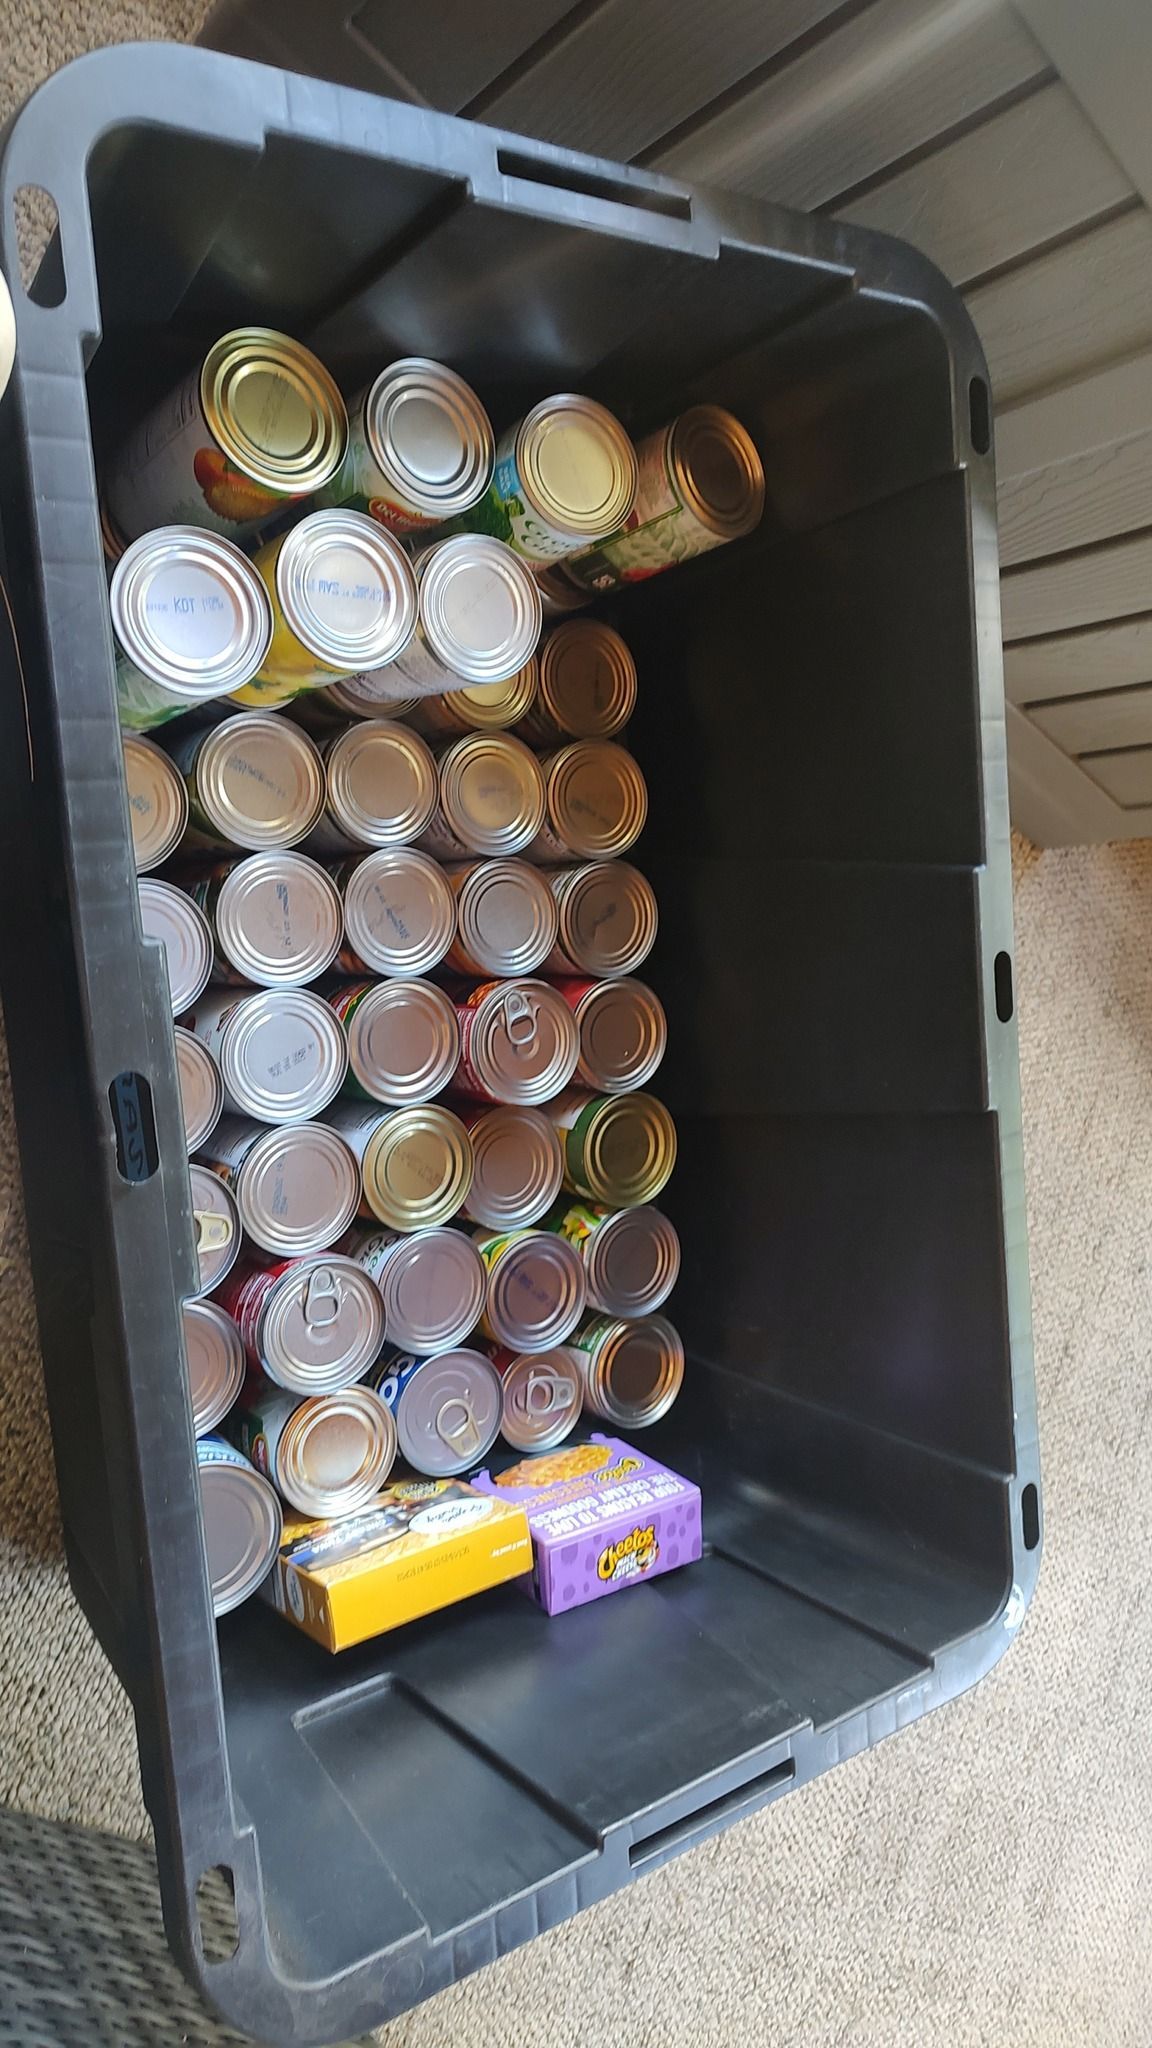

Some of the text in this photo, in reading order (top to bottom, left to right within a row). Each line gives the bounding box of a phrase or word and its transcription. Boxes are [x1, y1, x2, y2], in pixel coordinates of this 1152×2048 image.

[529, 1472, 679, 1528] THE CREAMY GOODNESS
[545, 1481, 686, 1536] FOUR REASONS TO LOVE
[597, 1523, 655, 1582] Cheetos
